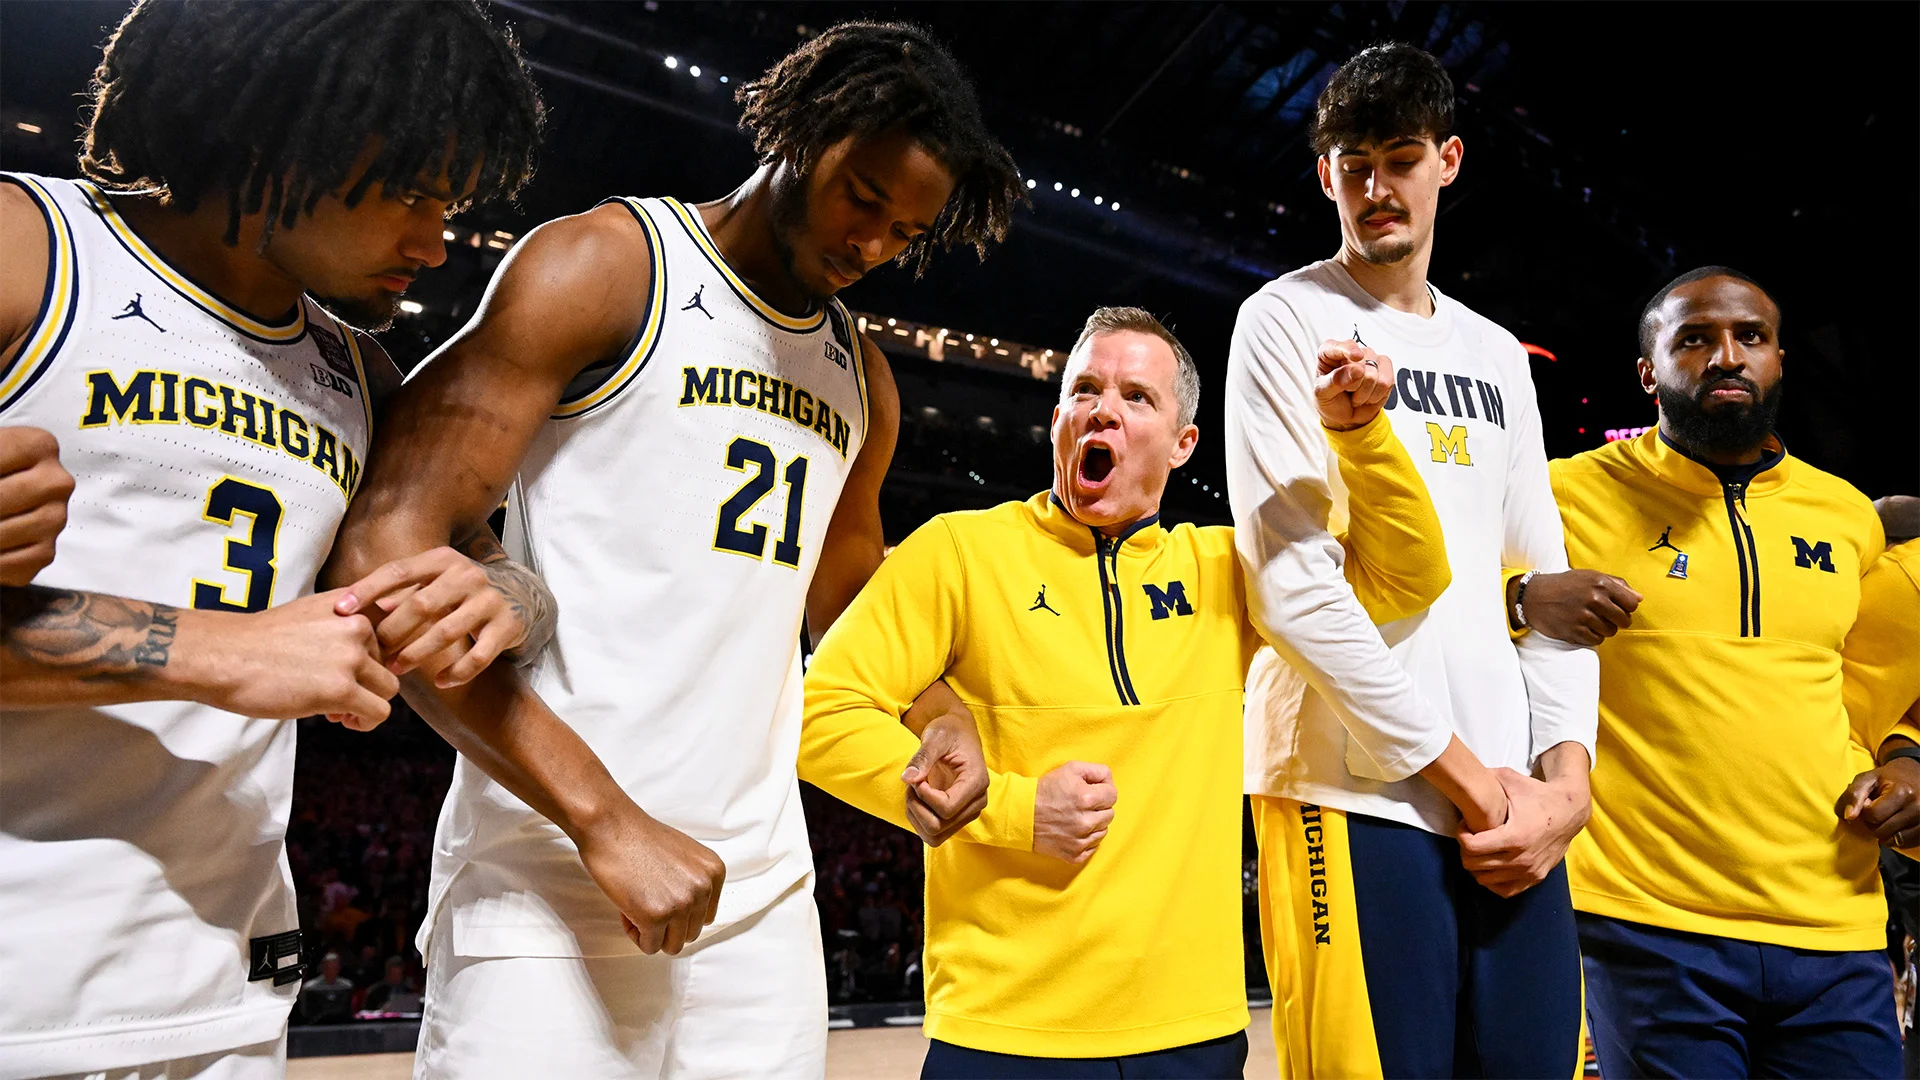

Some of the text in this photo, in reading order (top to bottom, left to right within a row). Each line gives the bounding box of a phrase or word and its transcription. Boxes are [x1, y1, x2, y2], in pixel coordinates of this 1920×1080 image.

[79, 369, 361, 506] MICHIGAN
[677, 366, 851, 462] MICHIGAN
[1443, 373, 1477, 419] IT
[1475, 379, 1505, 430] IN
[1425, 421, 1471, 467] M
[711, 435, 810, 570] 21
[190, 474, 284, 613] 3
[1790, 535, 1836, 573] M
[1141, 580, 1194, 620] M
